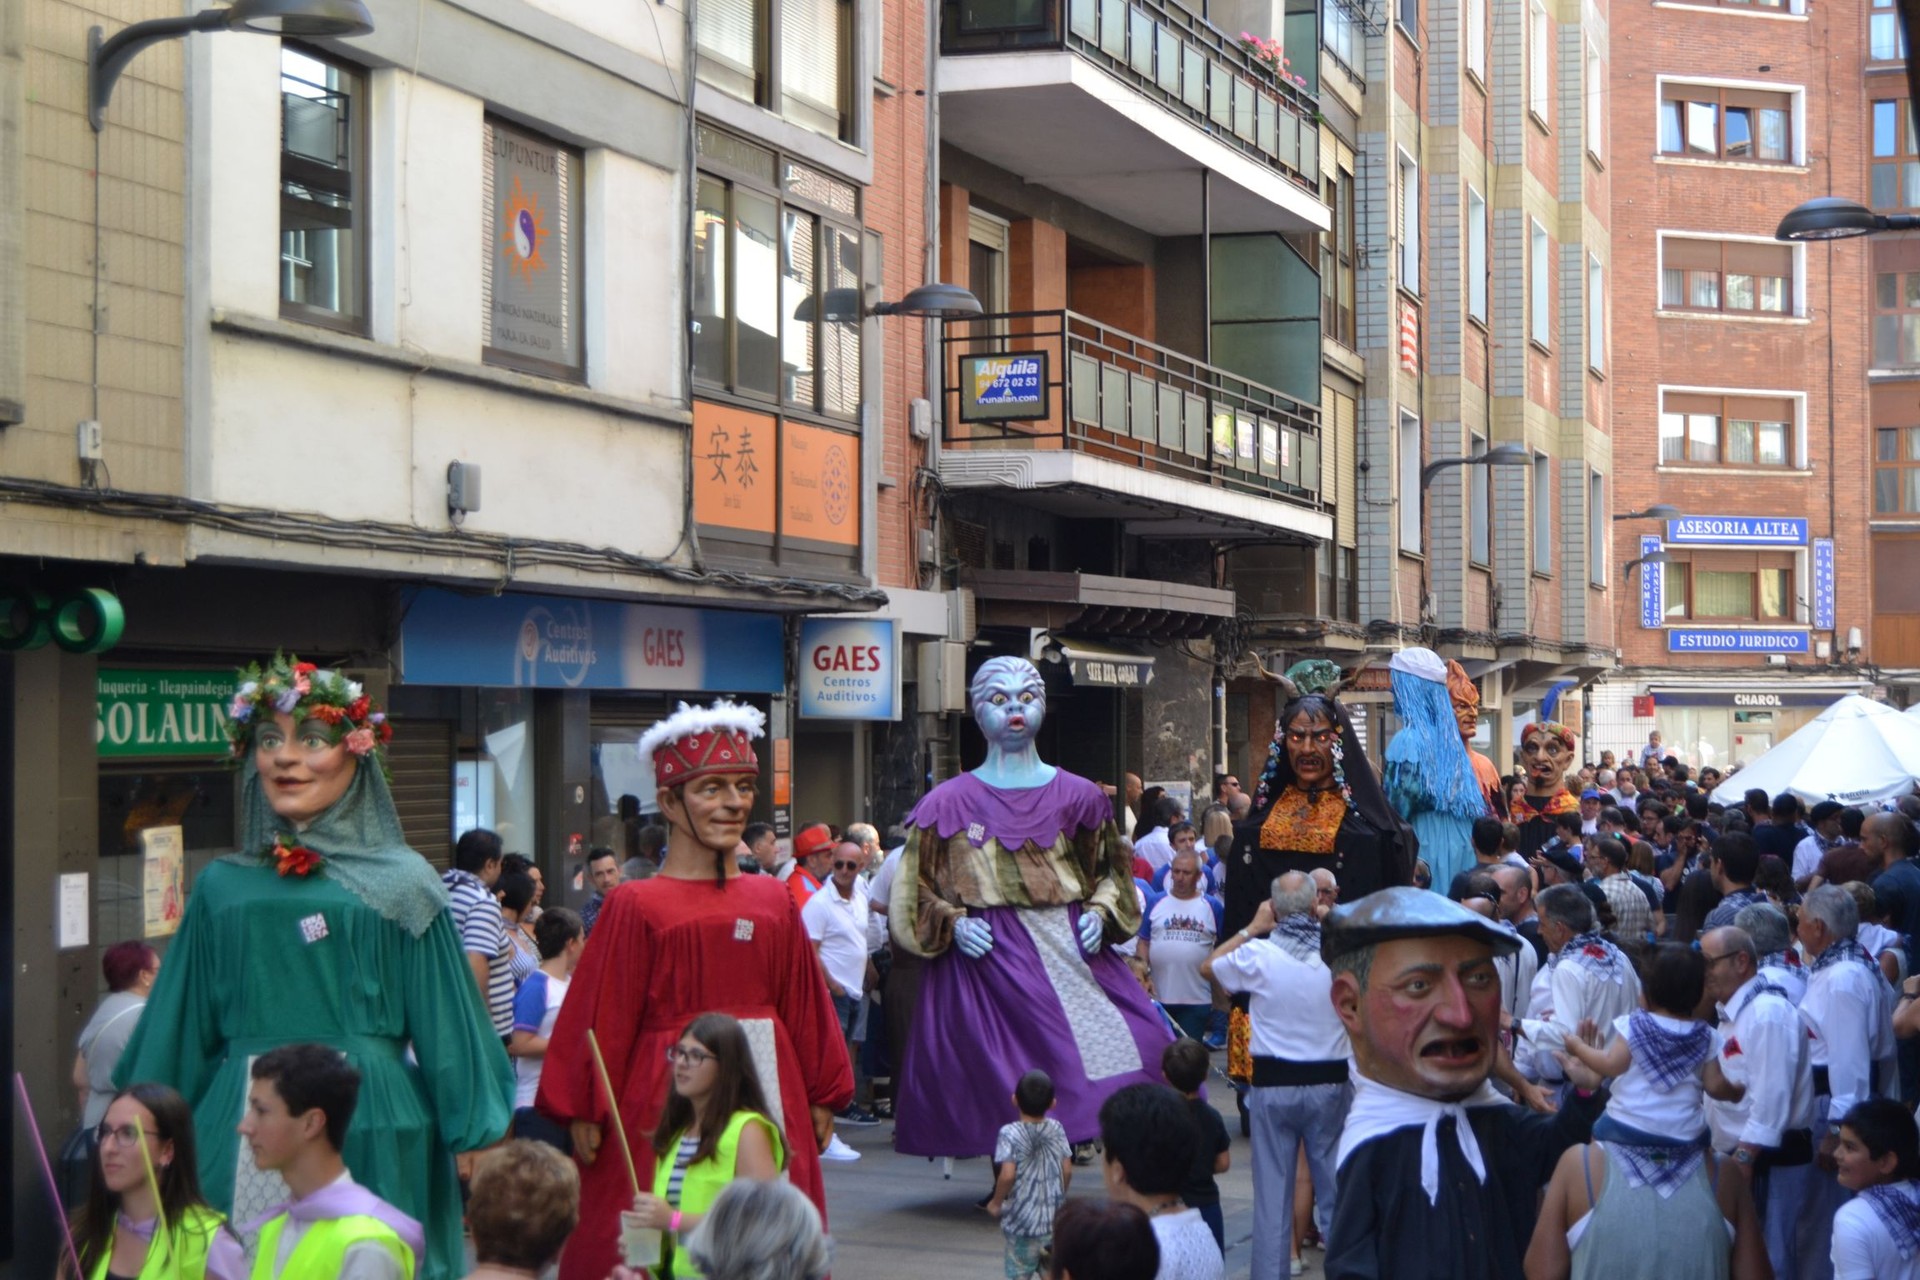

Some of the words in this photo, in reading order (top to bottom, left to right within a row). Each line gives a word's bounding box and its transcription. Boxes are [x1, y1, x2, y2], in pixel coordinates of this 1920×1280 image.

[979, 360, 1038, 378] Alquila
[993, 378, 1010, 388] 672
[1011, 378, 1024, 387] 02
[1025, 377, 1037, 387] 53
[1676, 520, 1749, 534] ASESORIA
[1754, 522, 1799, 535] ALTEA
[1643, 546, 1651, 626] EONOMICO
[547, 621, 588, 641] Centros
[643, 627, 684, 667] GAES
[1679, 635, 1736, 647] ESTUDIO
[1739, 635, 1799, 648] JURIDICO
[544, 646, 597, 665] Auditivos
[813, 645, 881, 672] GAES
[823, 676, 871, 688] Centros
[817, 690, 877, 702] Auditivos
[1734, 694, 1782, 706] CHAROL
